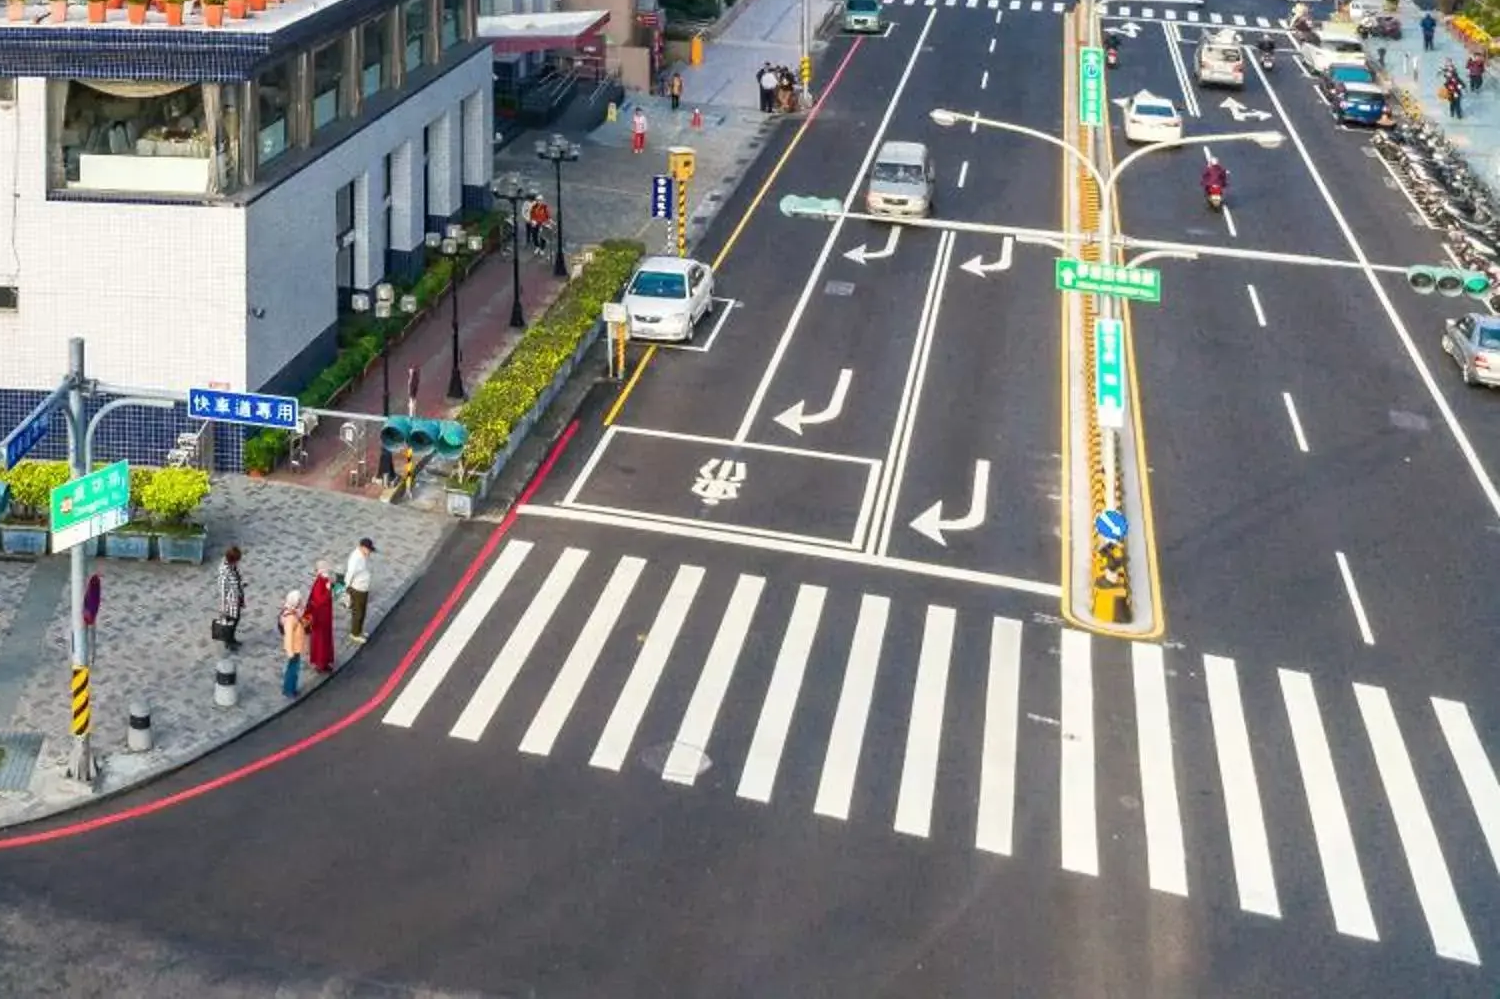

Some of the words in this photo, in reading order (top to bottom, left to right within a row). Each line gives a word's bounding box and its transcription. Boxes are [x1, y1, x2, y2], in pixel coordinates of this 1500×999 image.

[193, 393, 293, 422] 快車道專用
